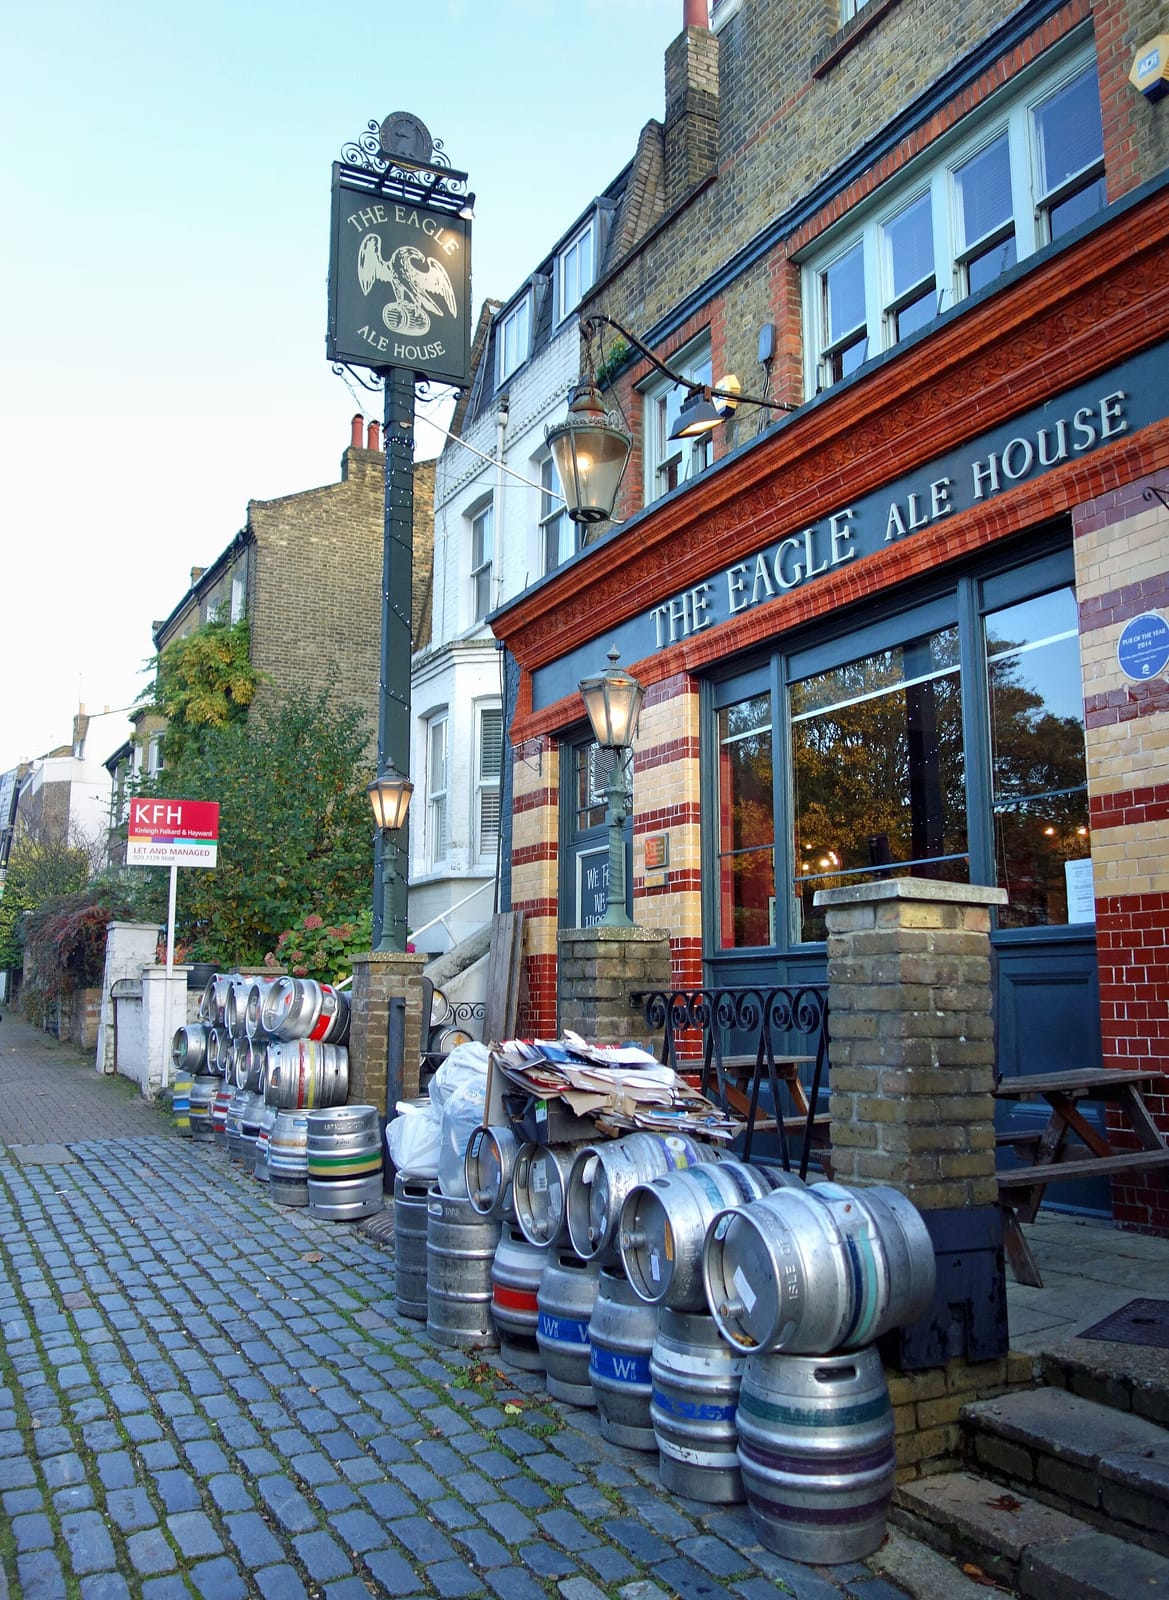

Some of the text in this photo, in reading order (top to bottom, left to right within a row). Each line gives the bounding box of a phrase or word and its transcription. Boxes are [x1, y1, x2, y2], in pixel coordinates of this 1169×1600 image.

[347, 205, 460, 256] THE EAGLE
[357, 325, 446, 360] ALE HOUSE
[650, 390, 1129, 649] THE EAGLE ALE HOUSE
[1122, 638, 1133, 646] PUB
[1141, 632, 1152, 640] THE
[1152, 627, 1166, 637] YEAR
[1137, 640, 1152, 649] 2014
[135, 804, 182, 825] KFH
[134, 827, 159, 835] Kinleigh
[159, 828, 180, 836] Folkard
[133, 847, 147, 855] LET
[169, 848, 210, 857] MANAGED
